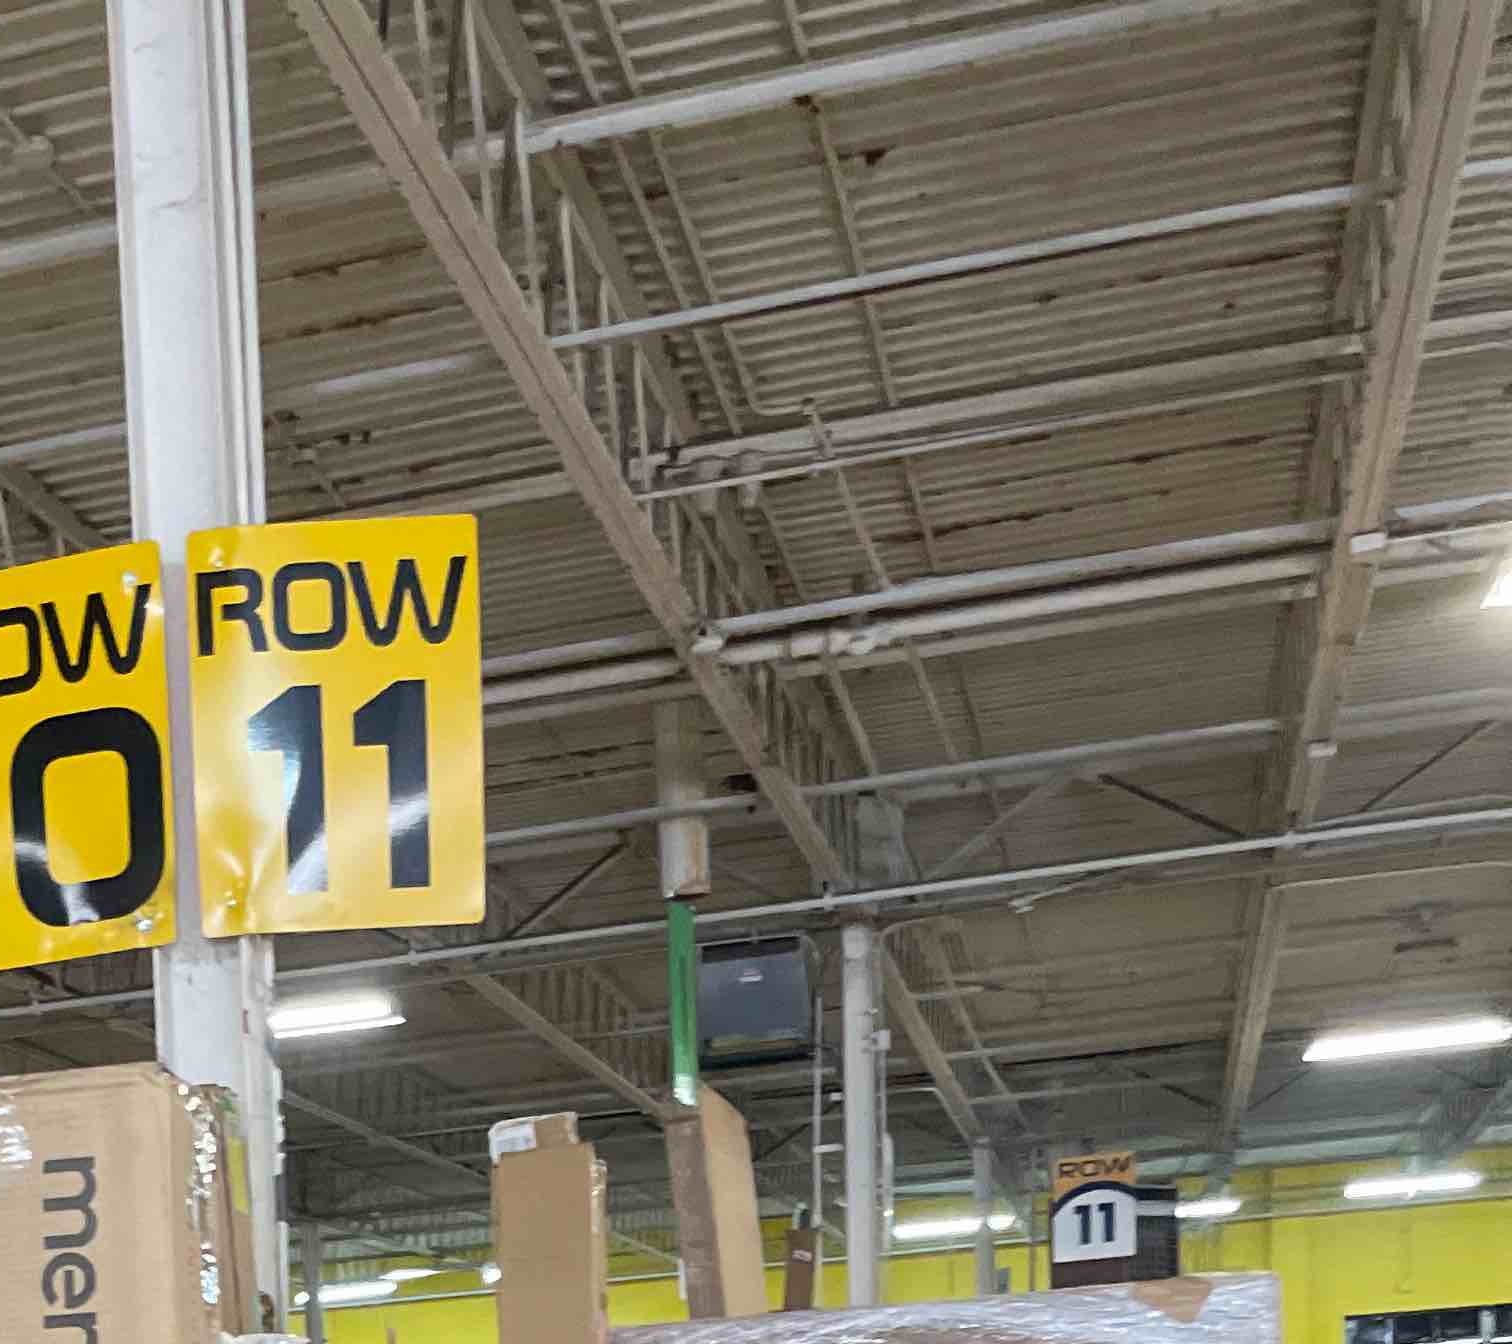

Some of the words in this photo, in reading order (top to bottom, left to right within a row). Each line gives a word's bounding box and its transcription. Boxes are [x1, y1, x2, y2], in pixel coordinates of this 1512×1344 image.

[195, 555, 467, 657] ROW
[248, 679, 431, 895] 11
[1059, 1156, 1132, 1178] ROW
[1074, 1201, 1115, 1245] 11
